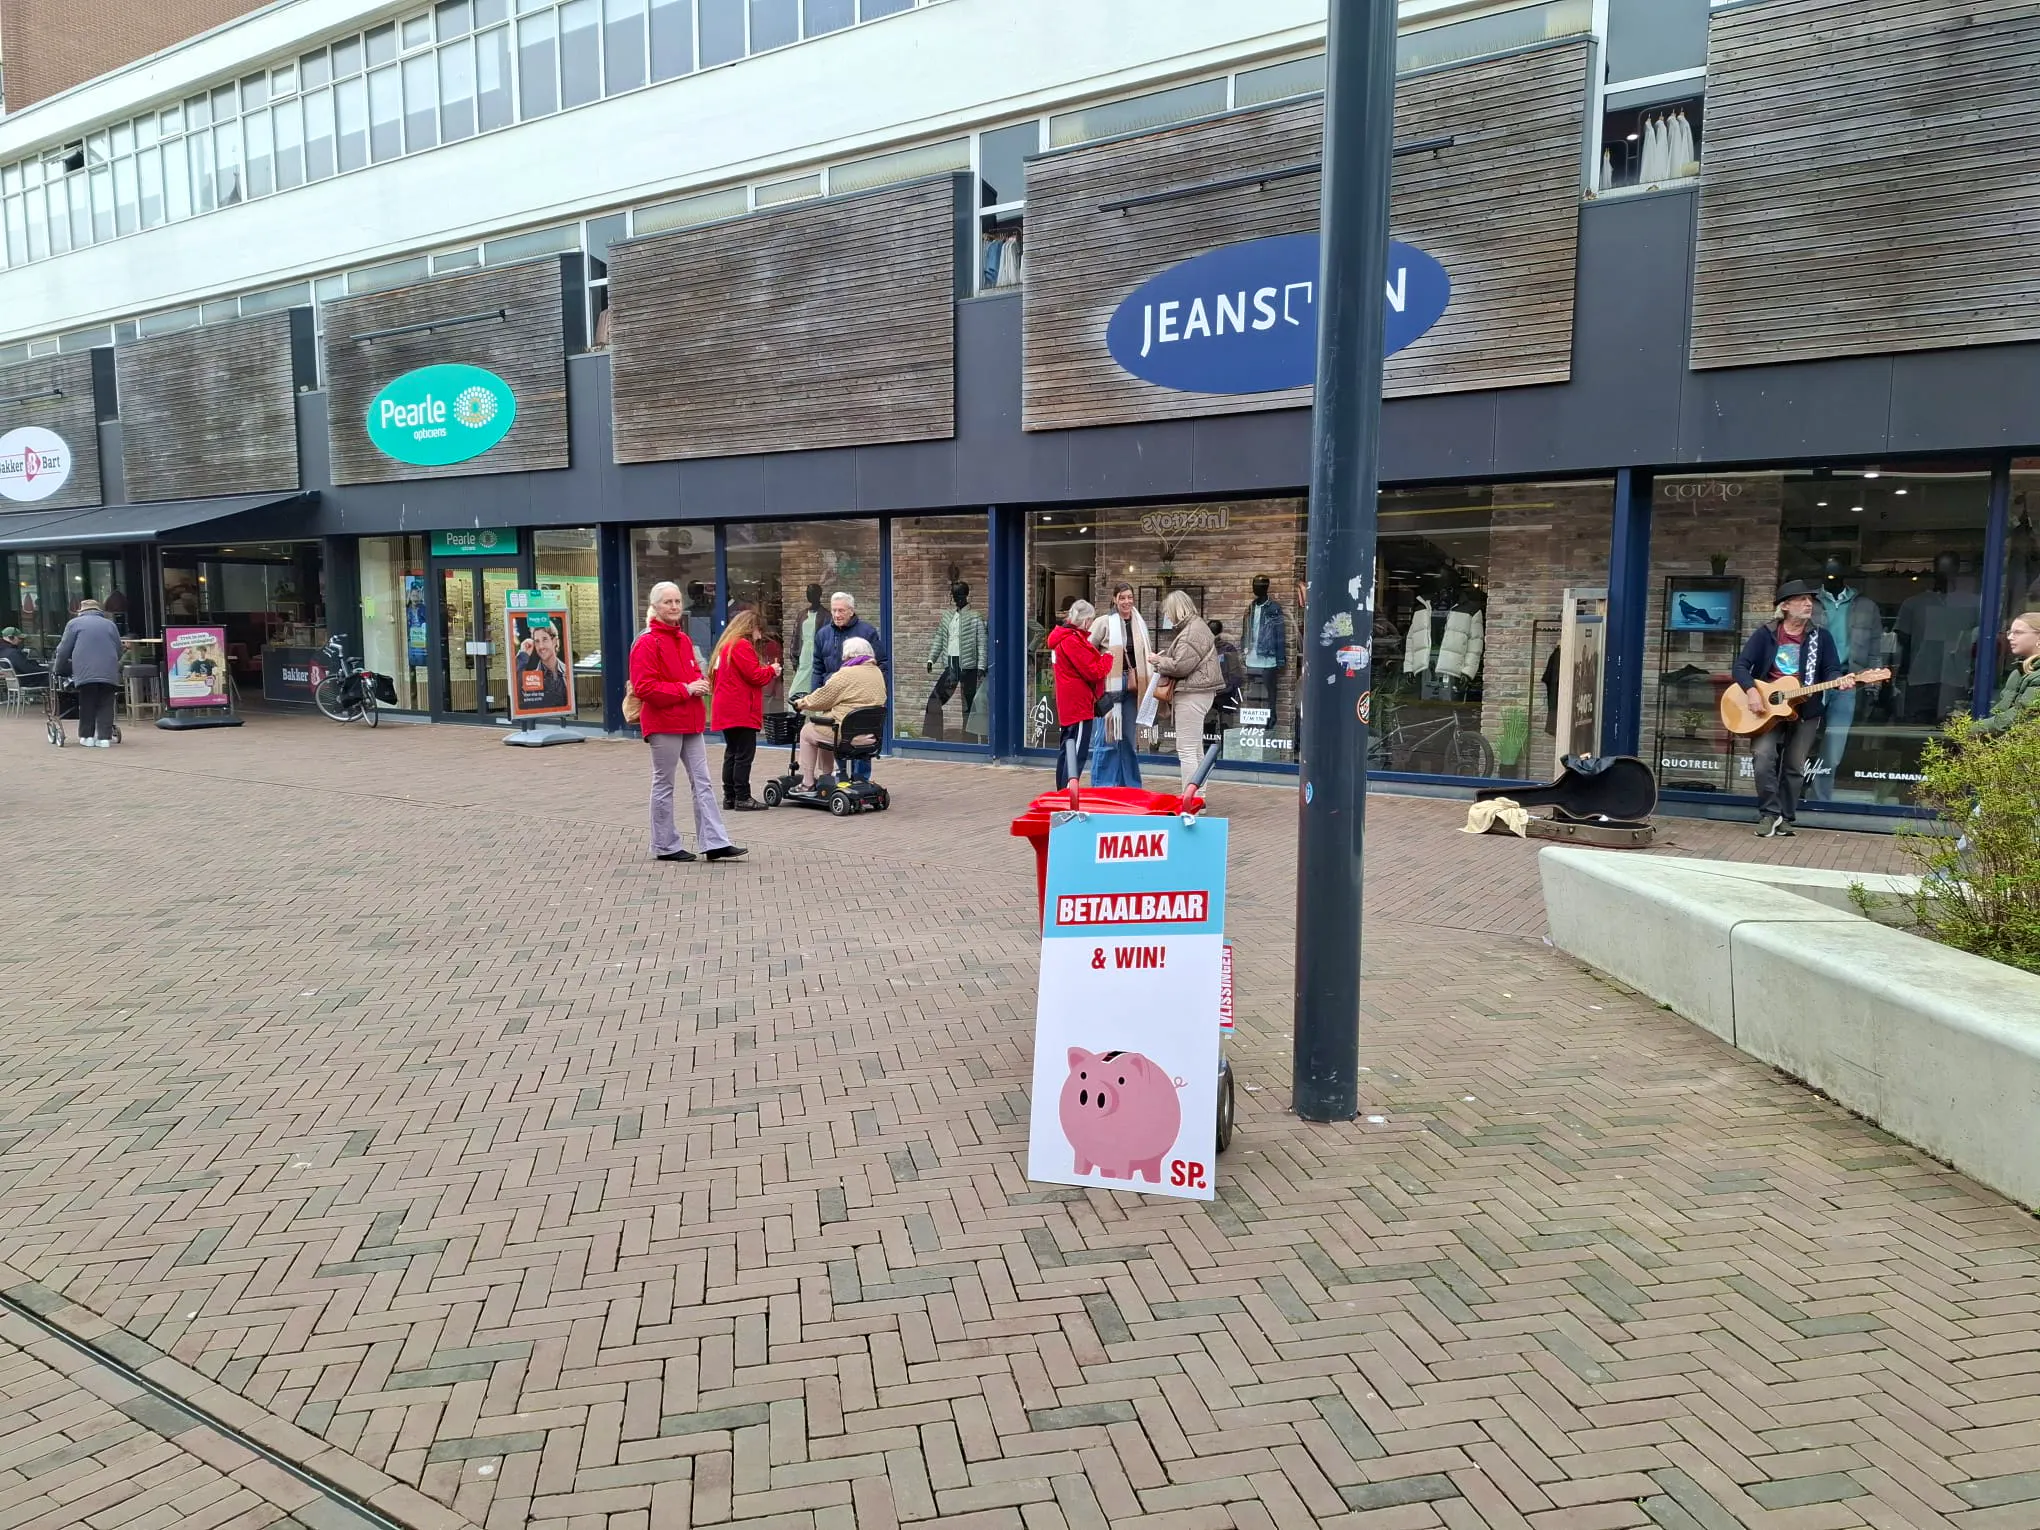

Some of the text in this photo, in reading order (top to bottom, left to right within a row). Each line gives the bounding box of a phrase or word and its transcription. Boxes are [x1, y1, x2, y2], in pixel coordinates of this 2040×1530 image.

[1140, 287, 1277, 358] JEANS
[381, 394, 446, 429] Pearle
[413, 428, 447, 441] opticiens
[0, 460, 24, 474] akker
[42, 456, 61, 469] Bart
[446, 532, 476, 545] Pearle
[282, 668, 308, 682] Bakker
[1240, 727, 1265, 737] KIDS
[1240, 738, 1293, 749] COLLECTIE
[1661, 758, 1719, 770] QUOTRELL
[1854, 770, 1929, 782] BLACK BANANA
[1098, 833, 1165, 860] MAAK
[1059, 893, 1204, 923] BETAALBAAR
[1091, 945, 1167, 970] & WIN!
[1220, 947, 1233, 1024] VLISSINGEN
